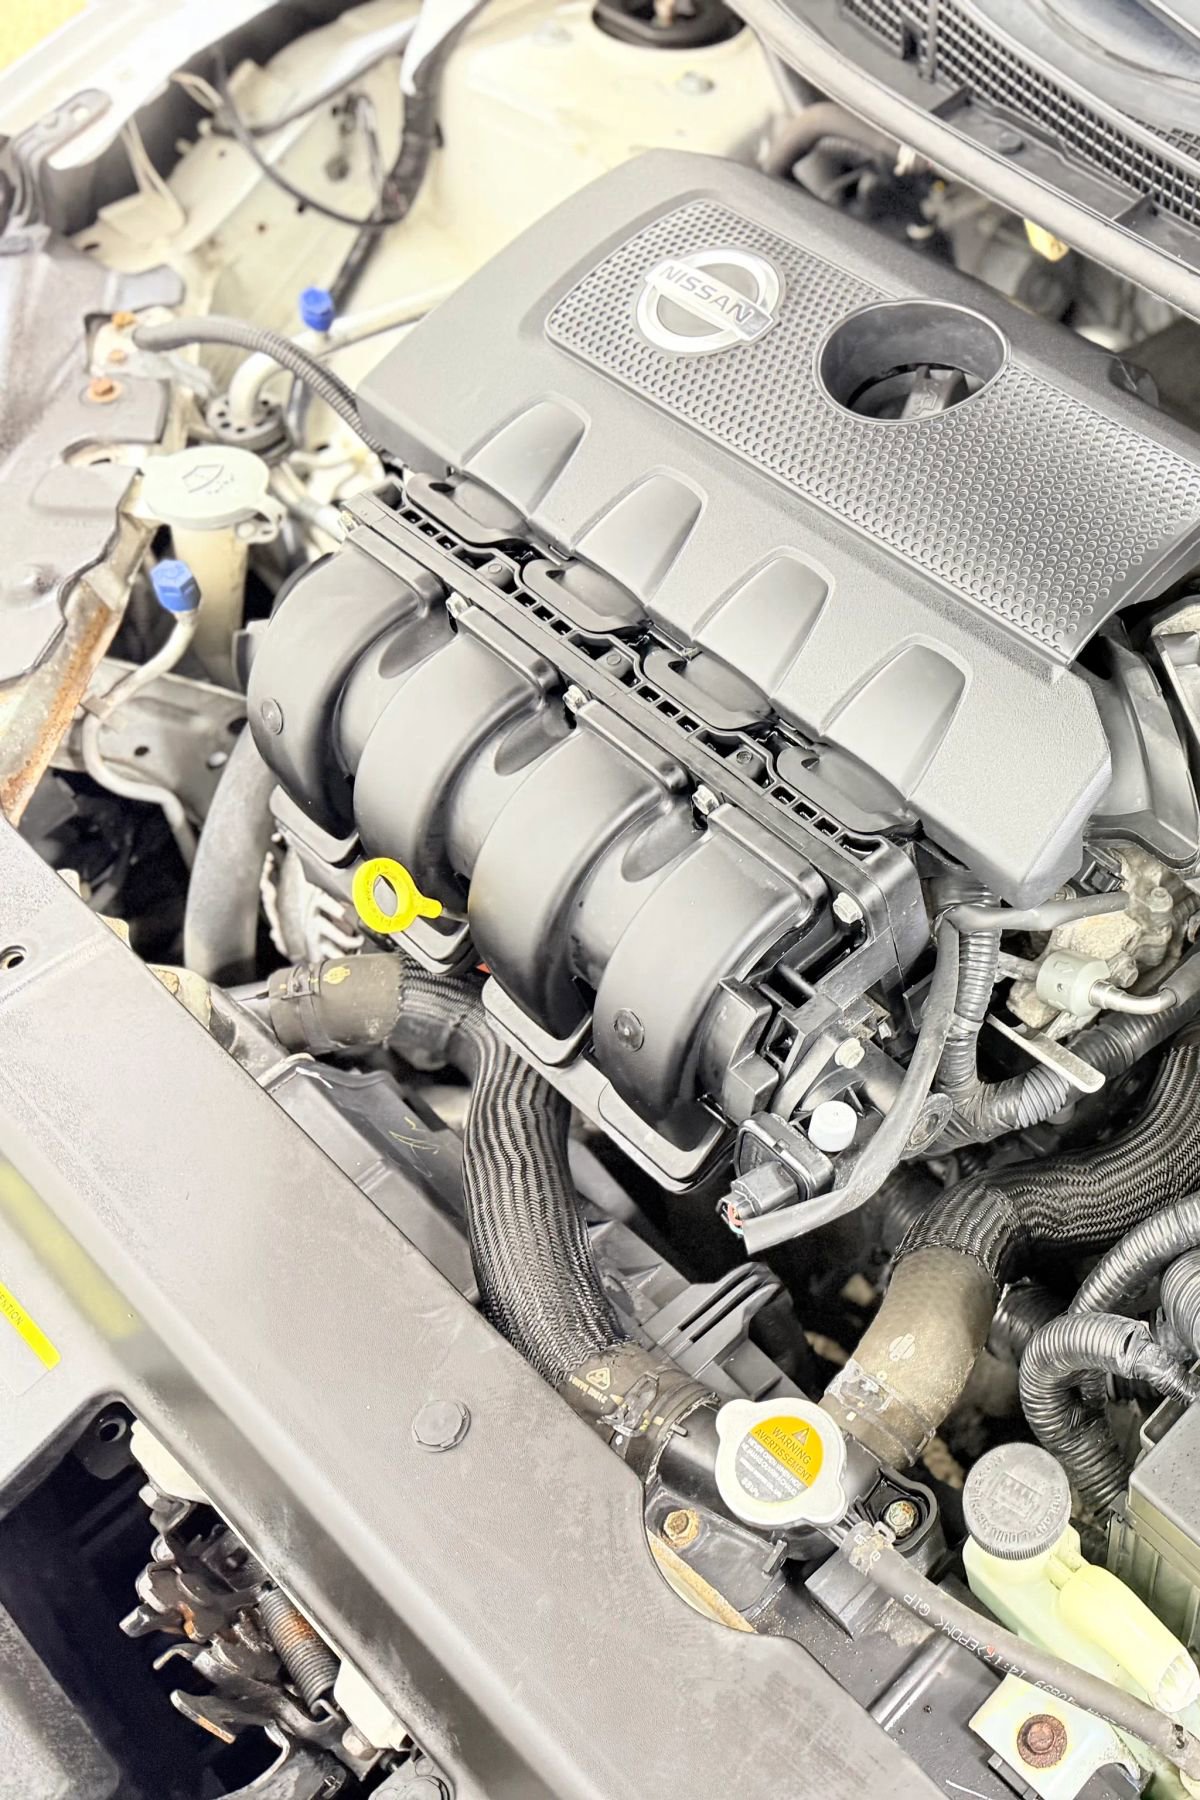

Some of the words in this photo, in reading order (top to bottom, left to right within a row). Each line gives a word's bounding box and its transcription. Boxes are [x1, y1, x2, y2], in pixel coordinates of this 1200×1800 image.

[659, 265, 751, 323] NISSAN
[755, 1429, 813, 1480] AVERTISSEMENT
[772, 1426, 811, 1464] WARNING
[903, 1592, 931, 1617] GIP
